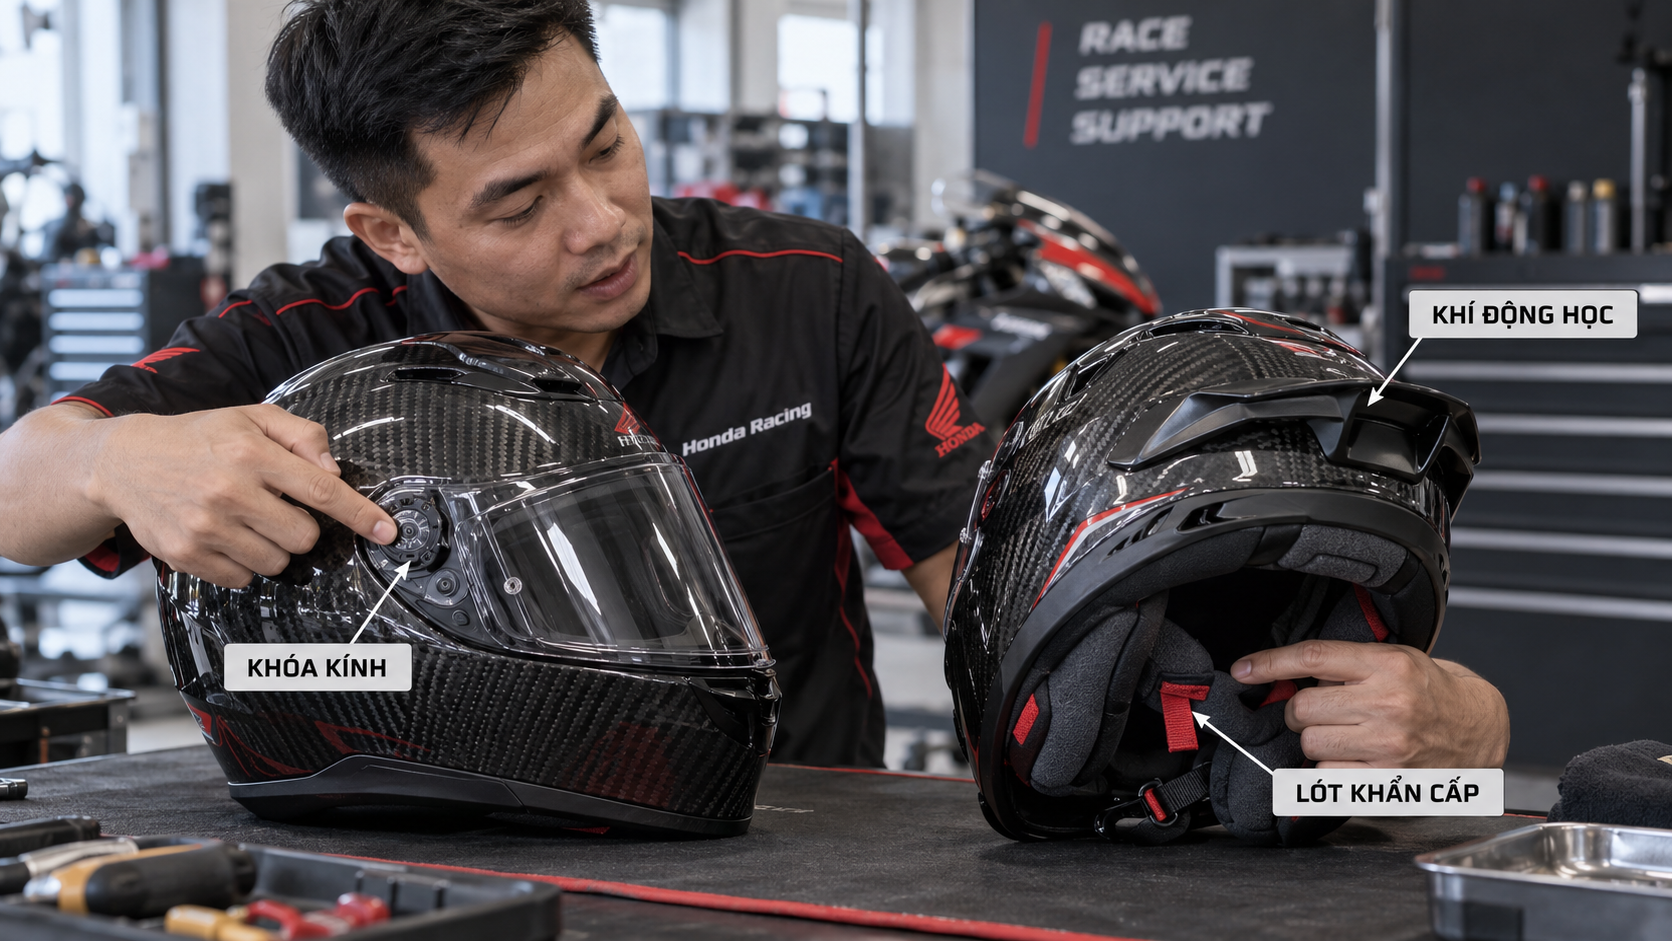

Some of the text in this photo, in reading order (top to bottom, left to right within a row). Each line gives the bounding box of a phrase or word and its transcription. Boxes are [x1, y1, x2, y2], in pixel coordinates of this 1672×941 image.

[1079, 15, 1192, 55] RACE
[1075, 57, 1253, 99] SERVICE
[1070, 102, 1273, 144] SUPPORT
[682, 426, 746, 457] Honda
[750, 402, 812, 435] Racing
[934, 422, 985, 458] HONDA
